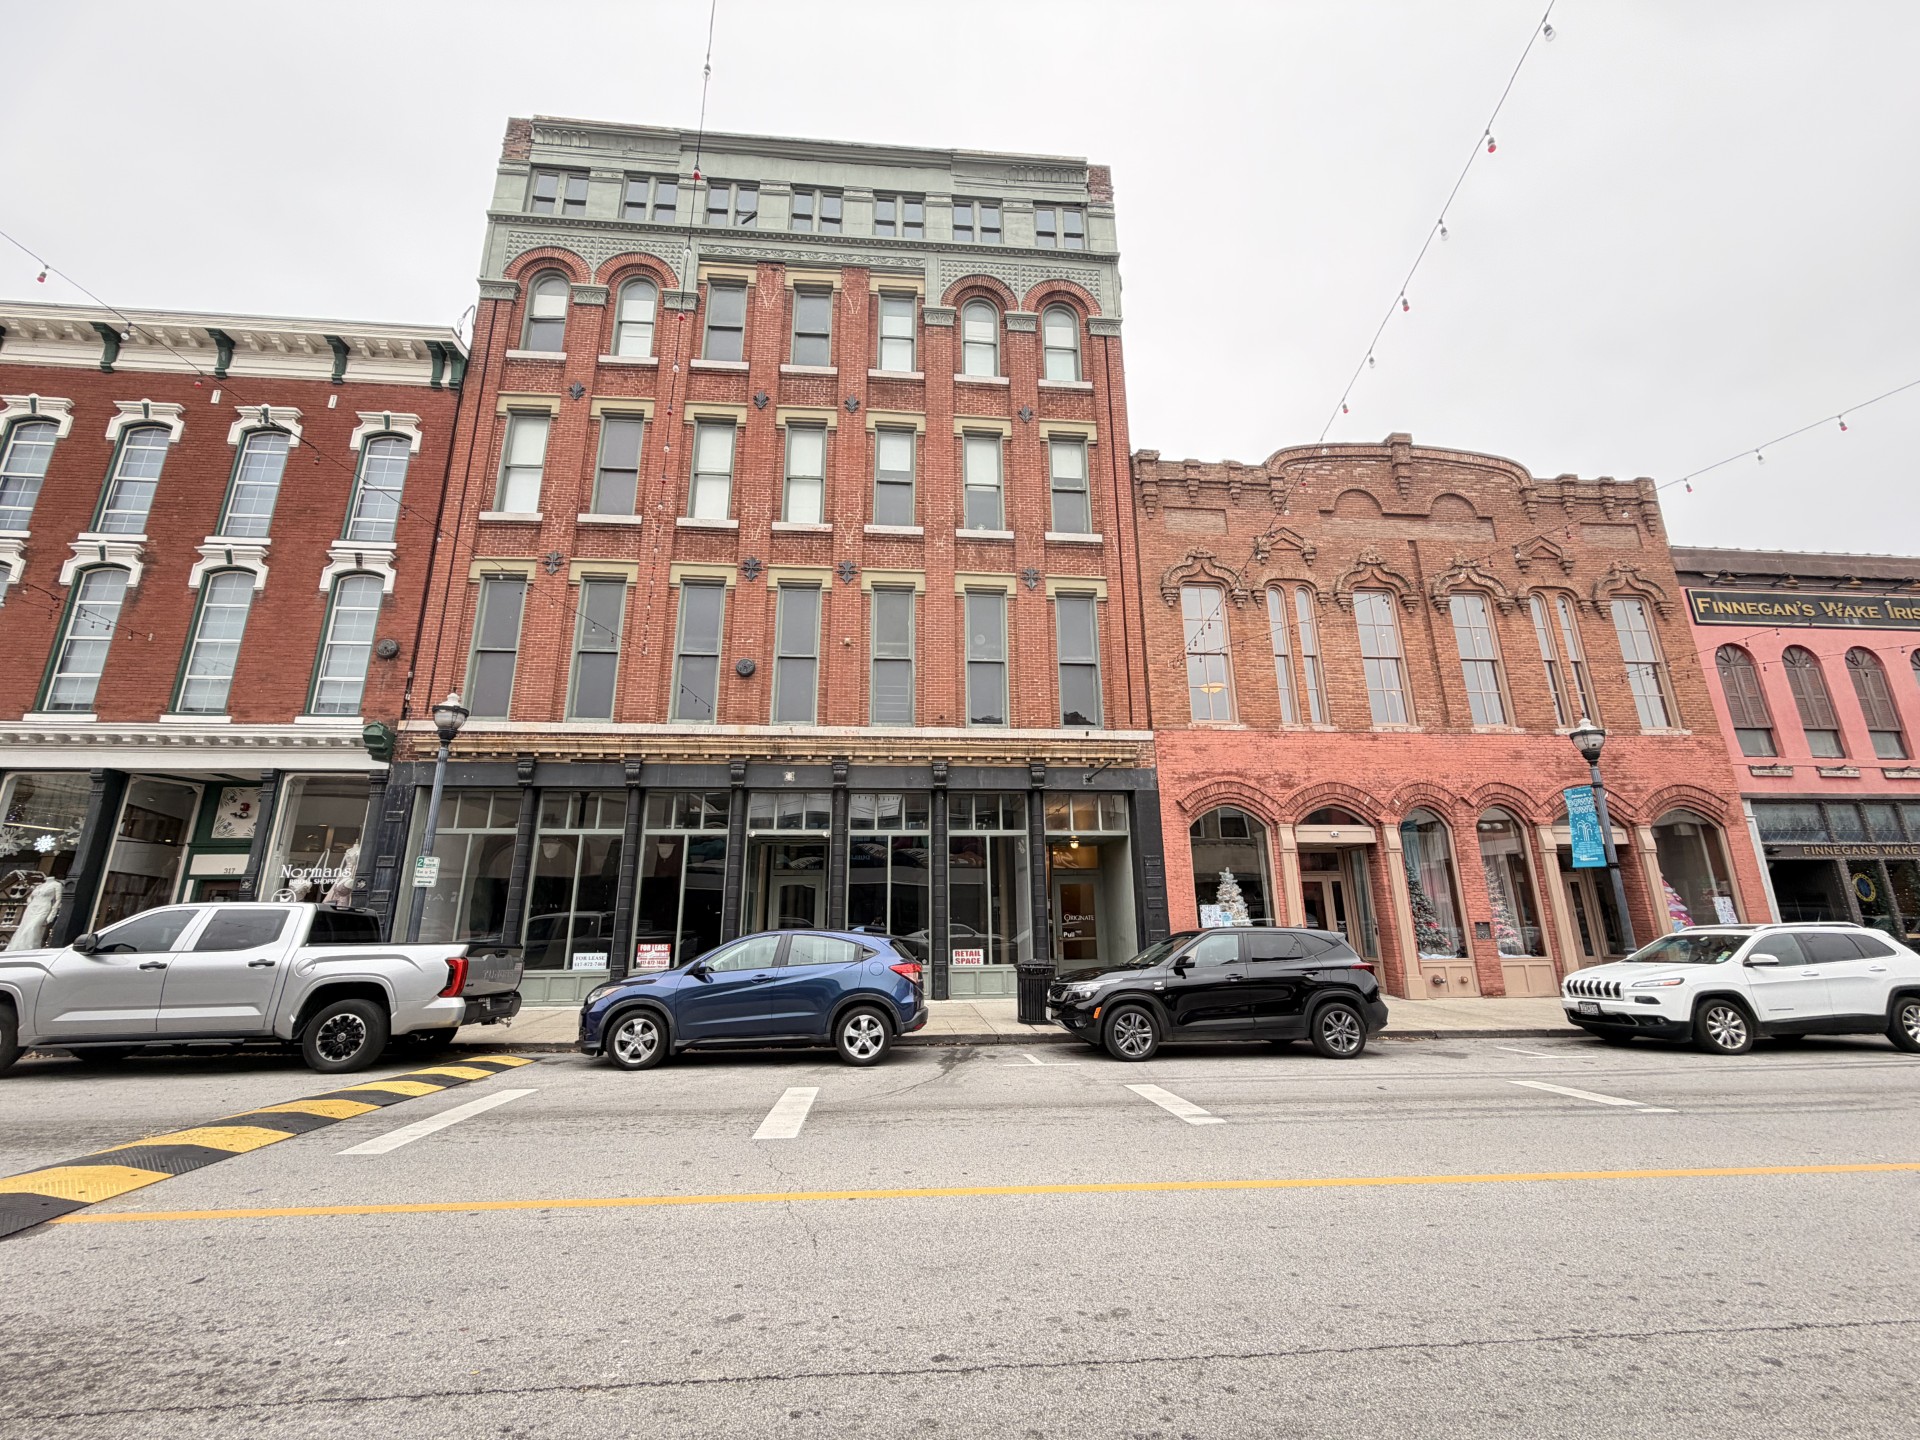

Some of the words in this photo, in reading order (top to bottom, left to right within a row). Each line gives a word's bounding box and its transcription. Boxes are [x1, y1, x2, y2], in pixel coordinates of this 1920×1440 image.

[1696, 597, 1816, 617] FINNEGAN'S
[1819, 601, 1882, 619] WAKE
[1803, 846, 1878, 856] FINNEGANS
[1882, 846, 1920, 855] WAKE
[418, 858, 424, 867] 2
[223, 867, 236, 875] 317
[279, 864, 352, 878] Normans
